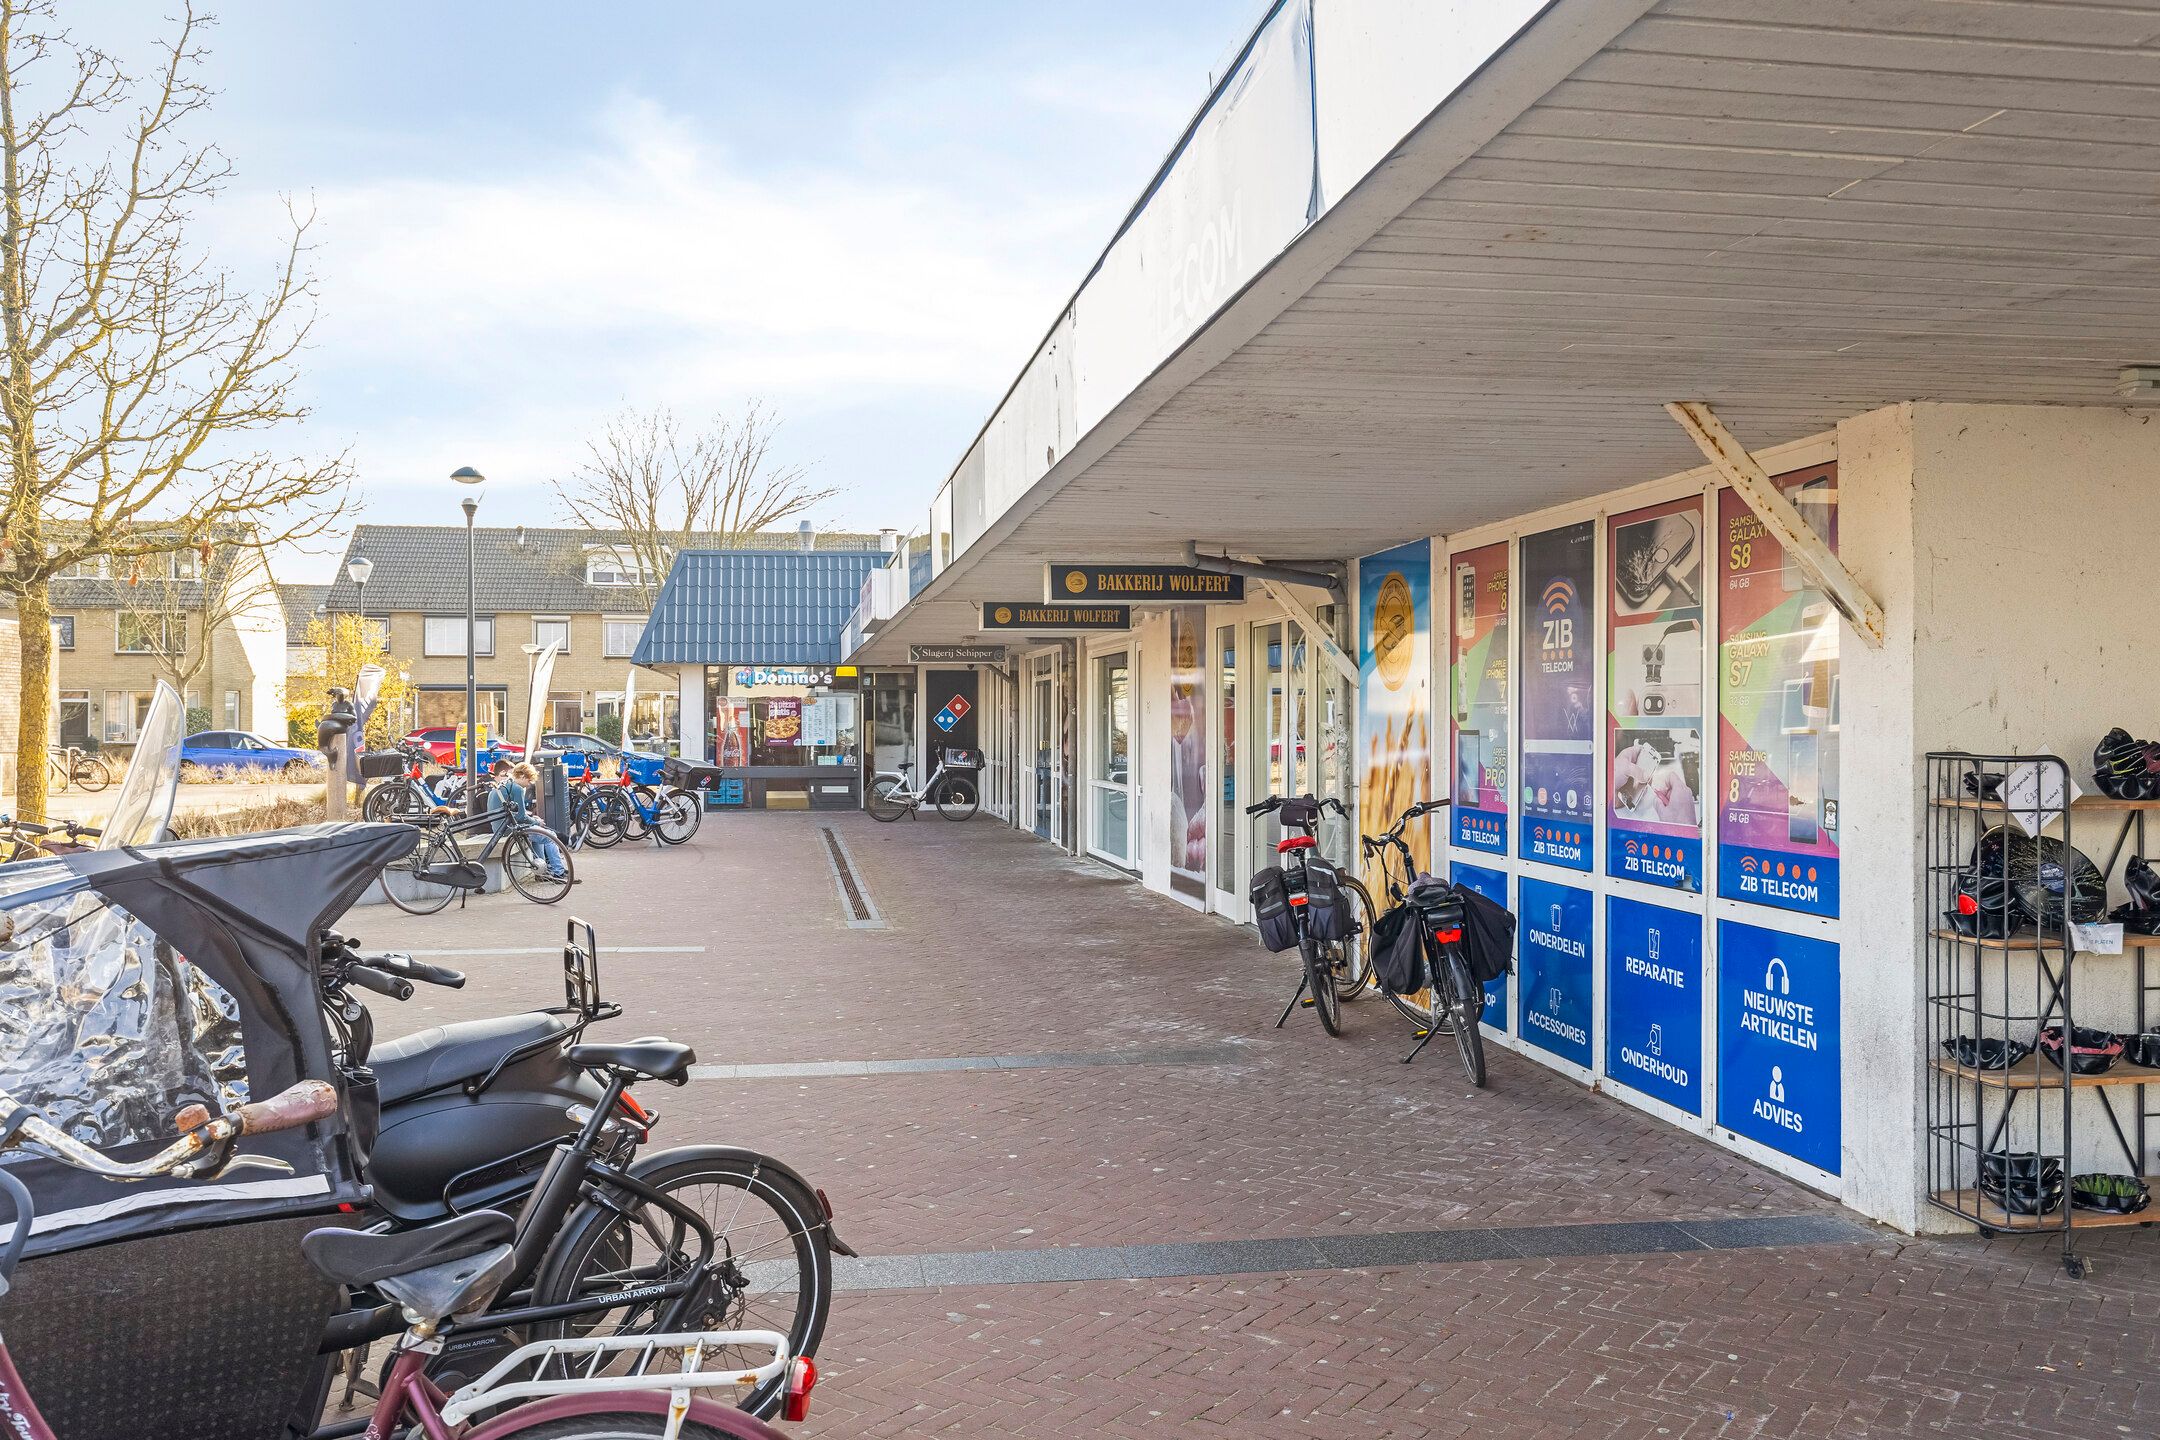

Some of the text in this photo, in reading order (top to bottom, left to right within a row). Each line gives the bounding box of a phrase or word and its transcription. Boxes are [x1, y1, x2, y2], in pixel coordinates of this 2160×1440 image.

[1729, 543, 1751, 570] S8
[1097, 574, 1231, 592] BAKKERIJ WOLFERT
[1739, 578, 1750, 588] GB
[1500, 592, 1507, 610] 8
[1019, 609, 1121, 623] BAKKERIJ WOLFERT
[1542, 618, 1573, 650] ZIB
[922, 649, 954, 659] Slagerij
[956, 649, 993, 658] Schipper
[1729, 643, 1770, 659] GALAXY
[1542, 661, 1573, 673] TELECOM
[1729, 660, 1752, 688] S7
[754, 671, 833, 685] Domino's
[1729, 750, 1767, 762] SAMSUNG
[1485, 768, 1507, 788] PRO
[1729, 763, 1756, 776] NOTE
[1729, 778, 1740, 803] 8
[1729, 812, 1750, 824] 64 GB
[1461, 828, 1500, 845] ZIB TELECOM
[1533, 841, 1581, 861] ZIB TELECOM
[1625, 857, 1685, 880] ZIB TELECOM
[1740, 875, 1818, 902] ZIB TELECOM
[1529, 928, 1585, 958] ONDERDELEN
[1626, 956, 1684, 988] REPARATIE
[1743, 989, 1814, 1026] NIEUWSTE
[1528, 1010, 1586, 1045] ACCESSOIRES
[1741, 1016, 1817, 1051] ARTIKELEN
[1621, 1047, 1688, 1087] ONDERHOUD
[1752, 1099, 1803, 1133] ADVIES
[598, 1285, 666, 1304] URBAN ARROW
[448, 1337, 496, 1352] URBAN ARROW
